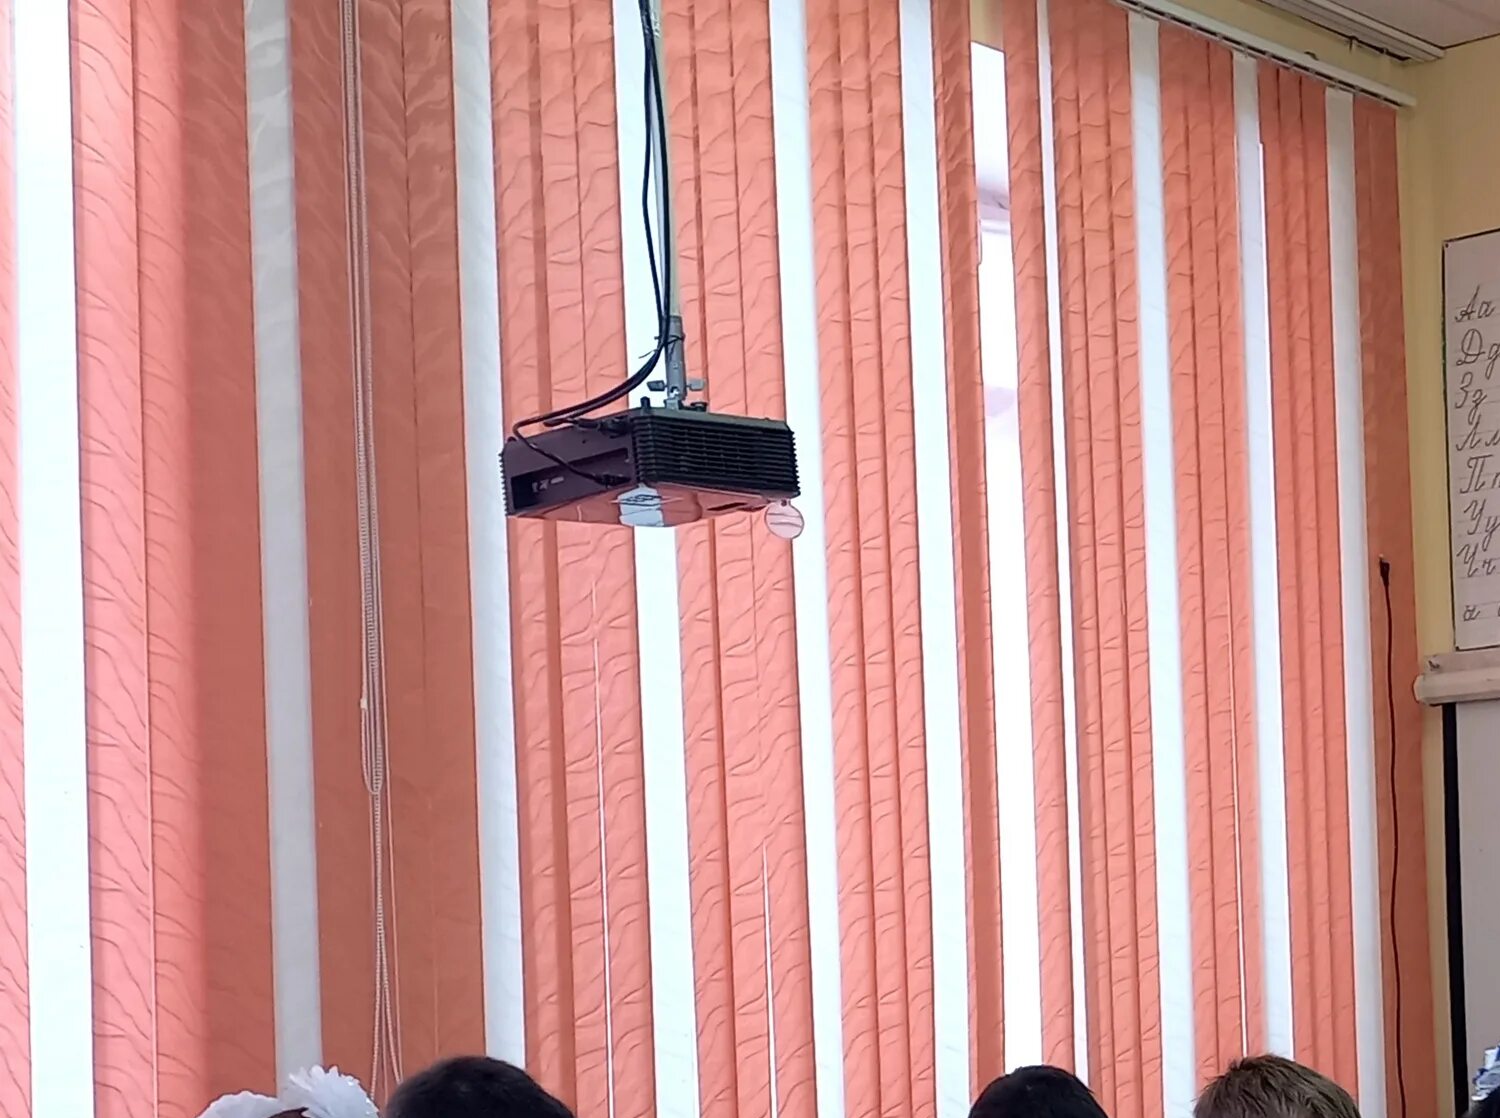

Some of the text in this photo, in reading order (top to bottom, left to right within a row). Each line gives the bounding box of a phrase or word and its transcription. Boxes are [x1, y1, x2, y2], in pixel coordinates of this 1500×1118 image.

[1455, 284, 1495, 322] Аа
[1455, 371, 1487, 425] Зз
[1464, 499, 1500, 552] Уу
[1457, 543, 1496, 577] Чч
